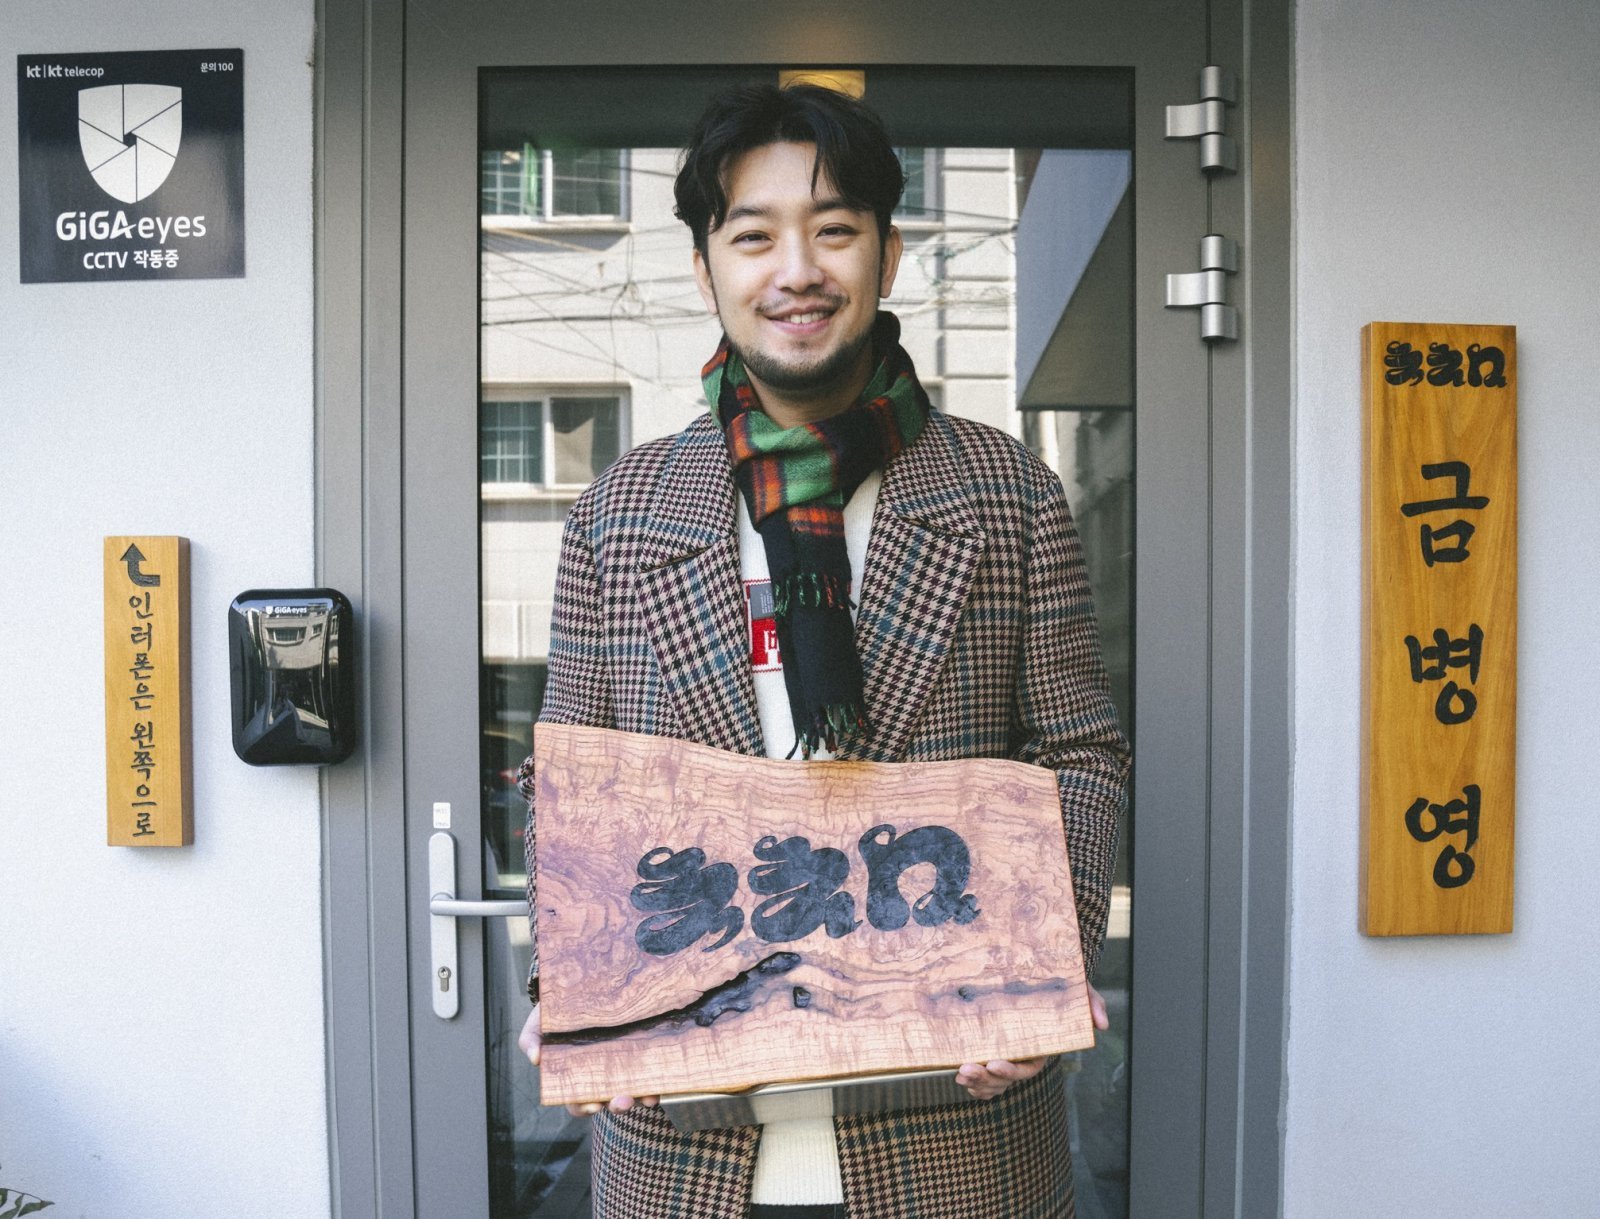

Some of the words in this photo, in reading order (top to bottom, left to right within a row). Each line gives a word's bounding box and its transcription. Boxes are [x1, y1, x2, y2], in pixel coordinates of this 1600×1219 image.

[48, 65, 63, 77] kt
[64, 66, 105, 78] telecop
[201, 62, 217, 73] 문의
[217, 62, 234, 71] 100
[83, 252, 128, 269] CCTV
[133, 249, 180, 269] 작동중
[128, 591, 155, 711] 인터폰은
[130, 721, 157, 837] 왼쪽으로
